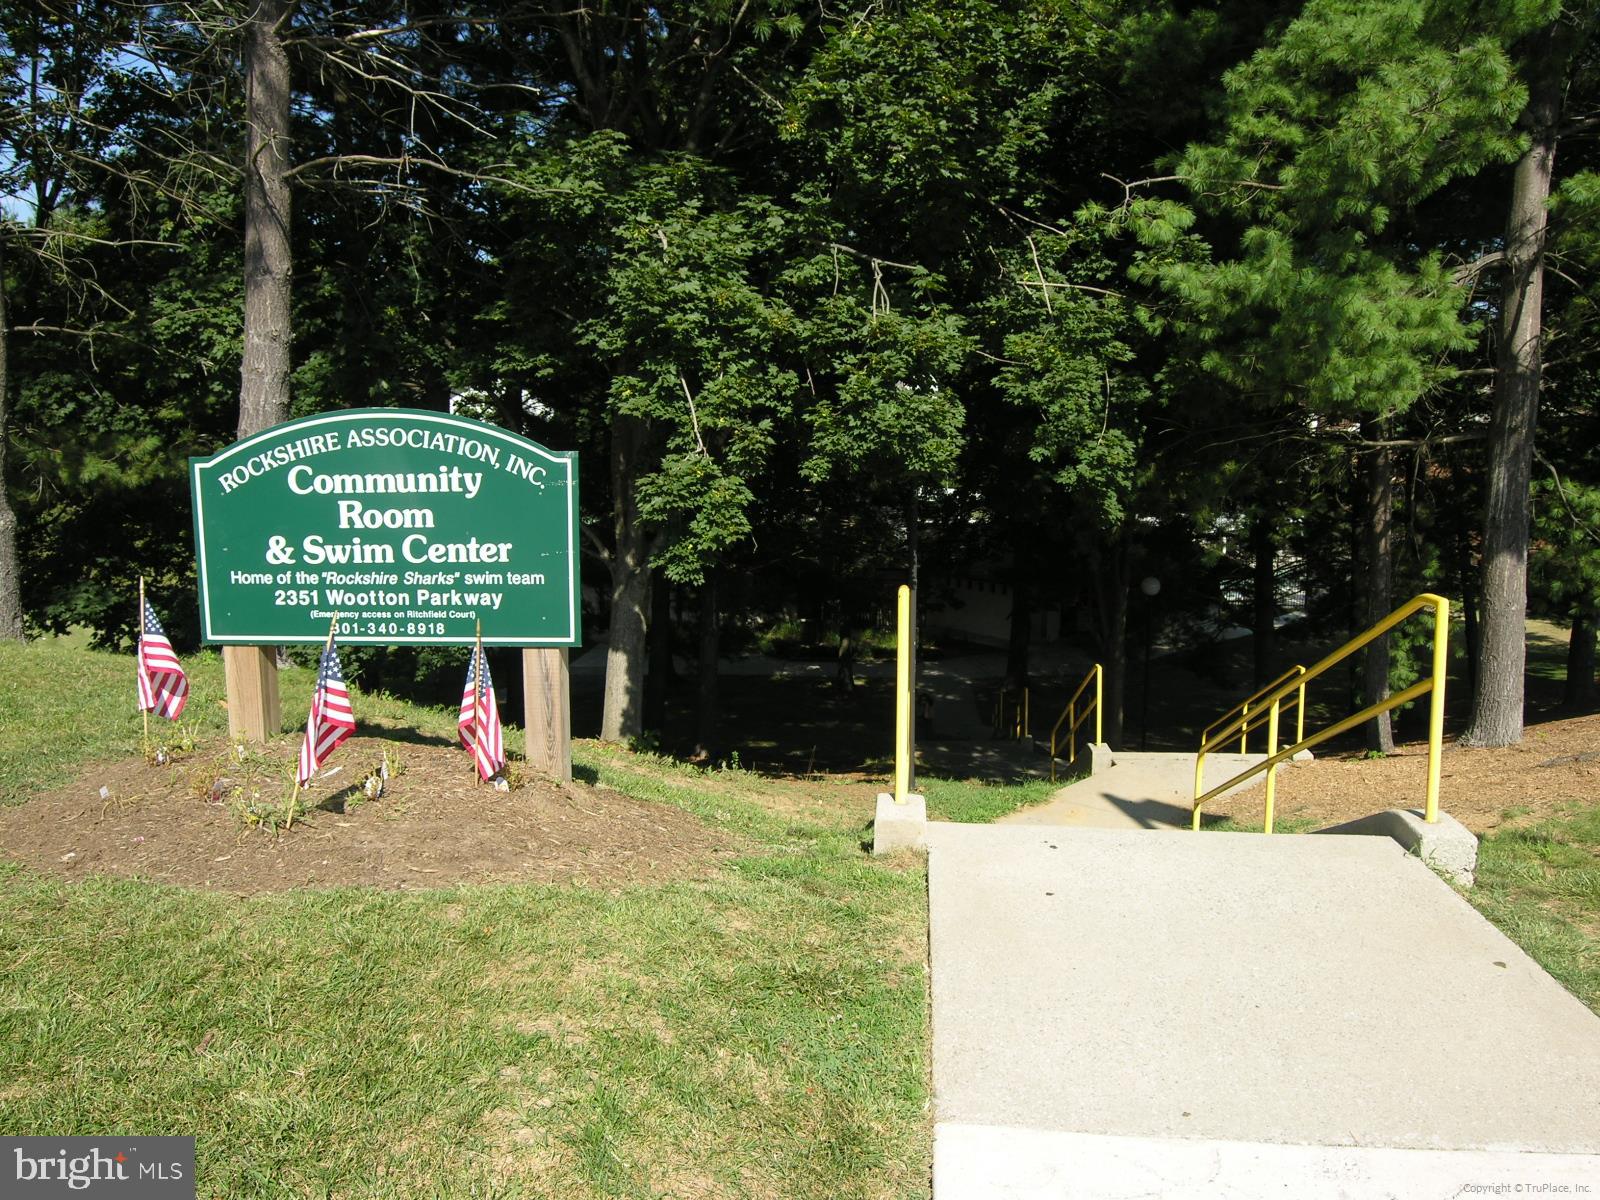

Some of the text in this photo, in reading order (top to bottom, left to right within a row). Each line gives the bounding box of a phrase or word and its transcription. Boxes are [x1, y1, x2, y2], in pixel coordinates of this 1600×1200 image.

[218, 427, 547, 494] ROCKSHIRE ASSOCIATION, INC.
[287, 464, 483, 499] Community
[337, 499, 435, 529] Room
[265, 533, 513, 565] & Swim Center
[230, 570, 545, 585] Home of the "Rockshire Sharks" swim team
[274, 589, 502, 610] 2351 Wootton Parkway
[310, 610, 360, 619] (Emergency
[361, 611, 392, 619] access
[406, 610, 447, 619] Ritchfield
[449, 610, 476, 620] Court)
[333, 622, 445, 635] 301-340-8918
